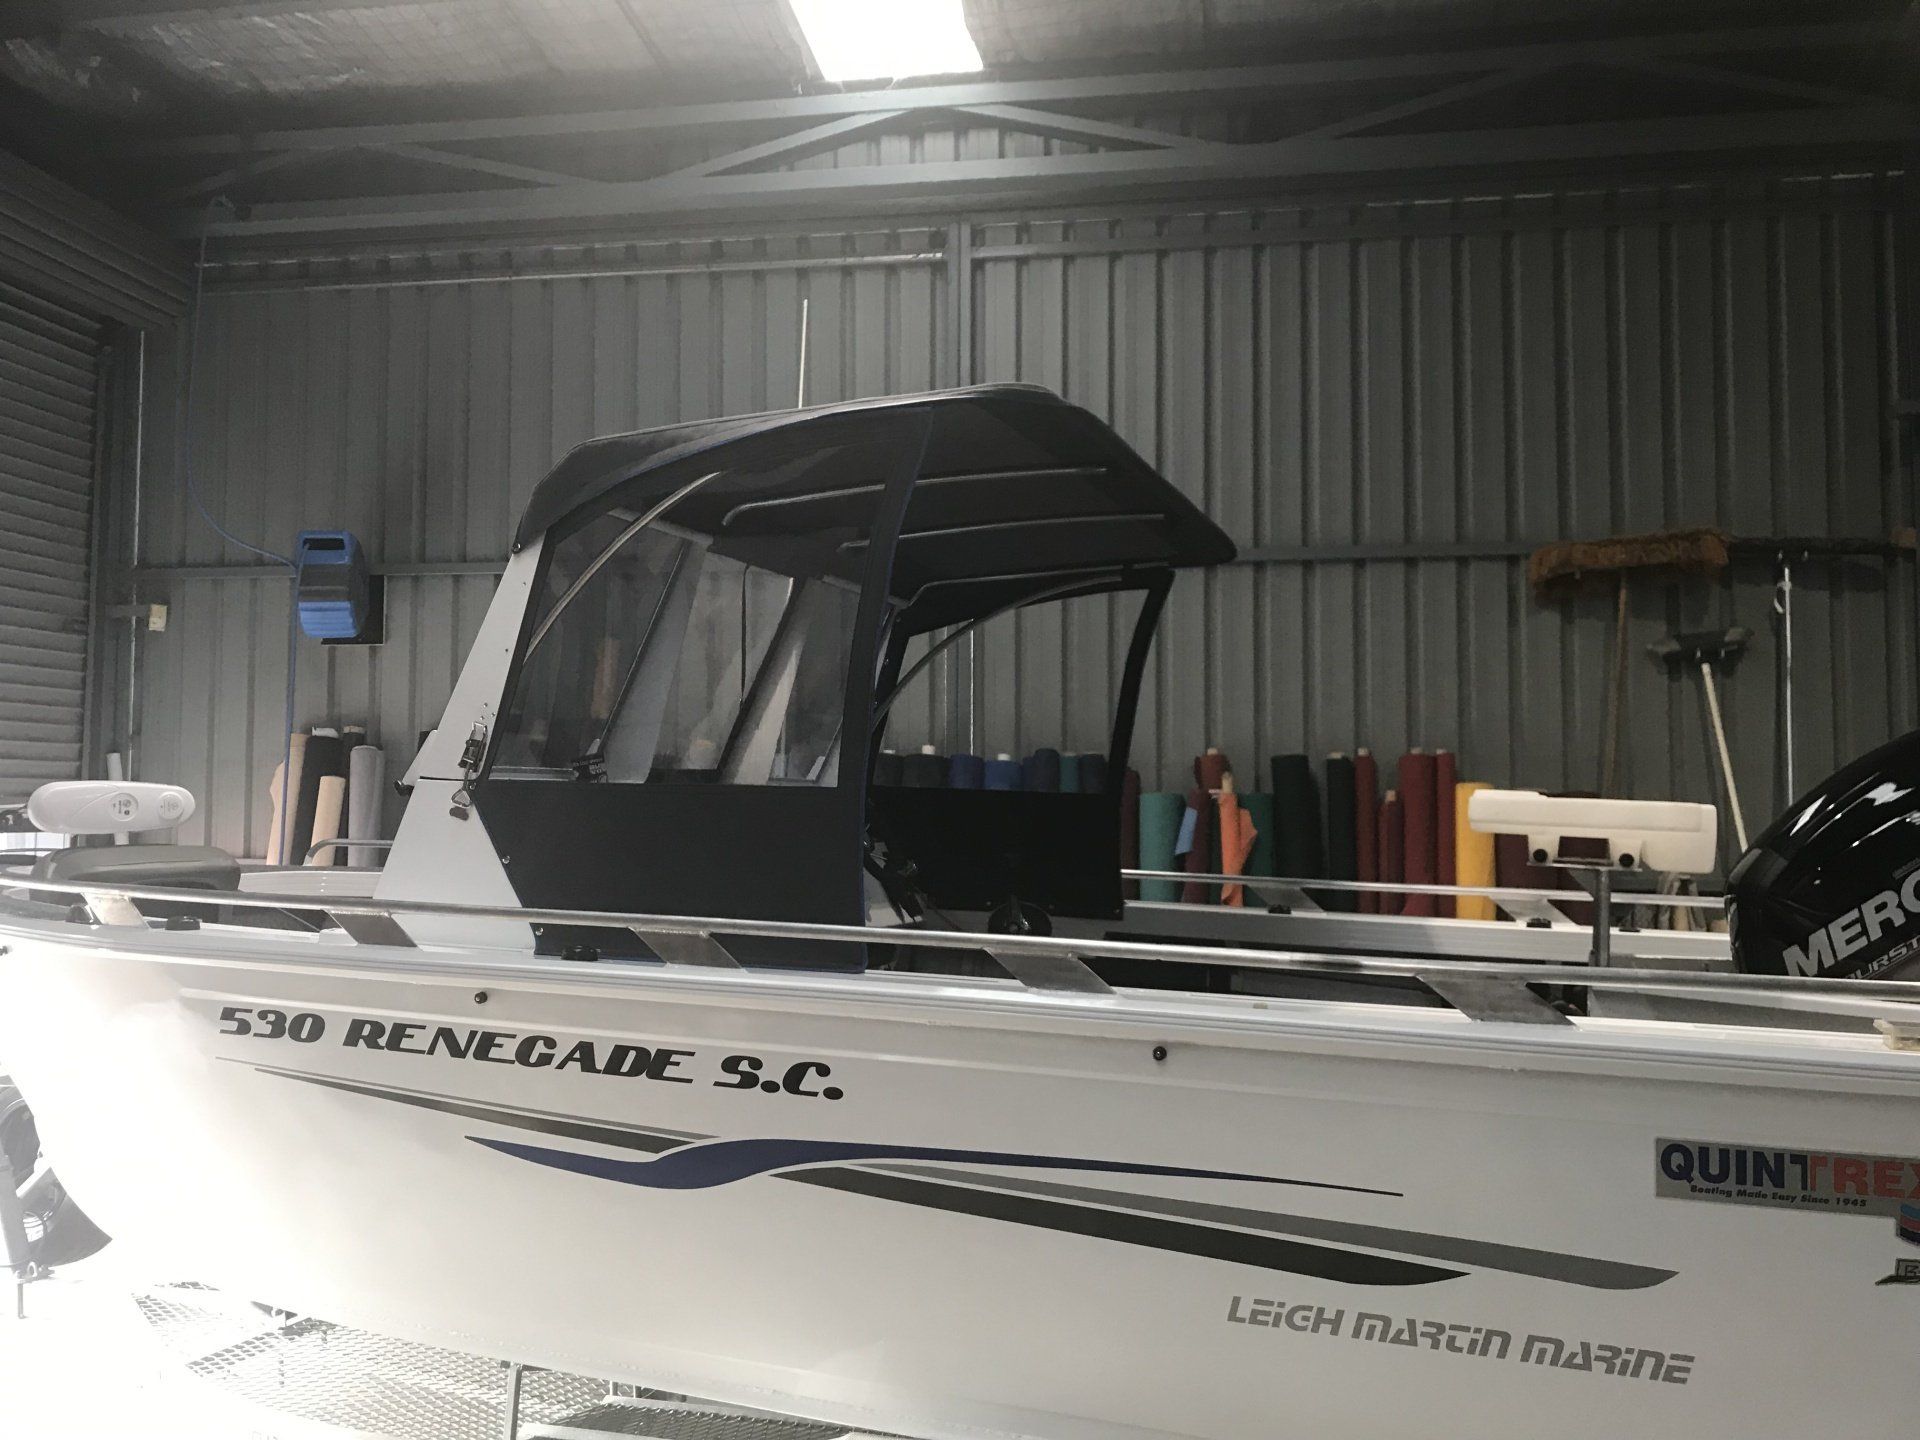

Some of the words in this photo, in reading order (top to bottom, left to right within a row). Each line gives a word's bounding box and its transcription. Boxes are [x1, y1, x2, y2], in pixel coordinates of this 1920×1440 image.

[219, 1007, 326, 1043] 530
[342, 1018, 696, 1084] RENEGADE
[712, 1054, 844, 1101] S.C.
[1690, 1184, 1732, 1198] Boating
[1736, 1189, 1768, 1199] Made
[1772, 1192, 1797, 1203] Easy
[1801, 1194, 1830, 1205] Since
[1836, 1197, 1867, 1207] 1945
